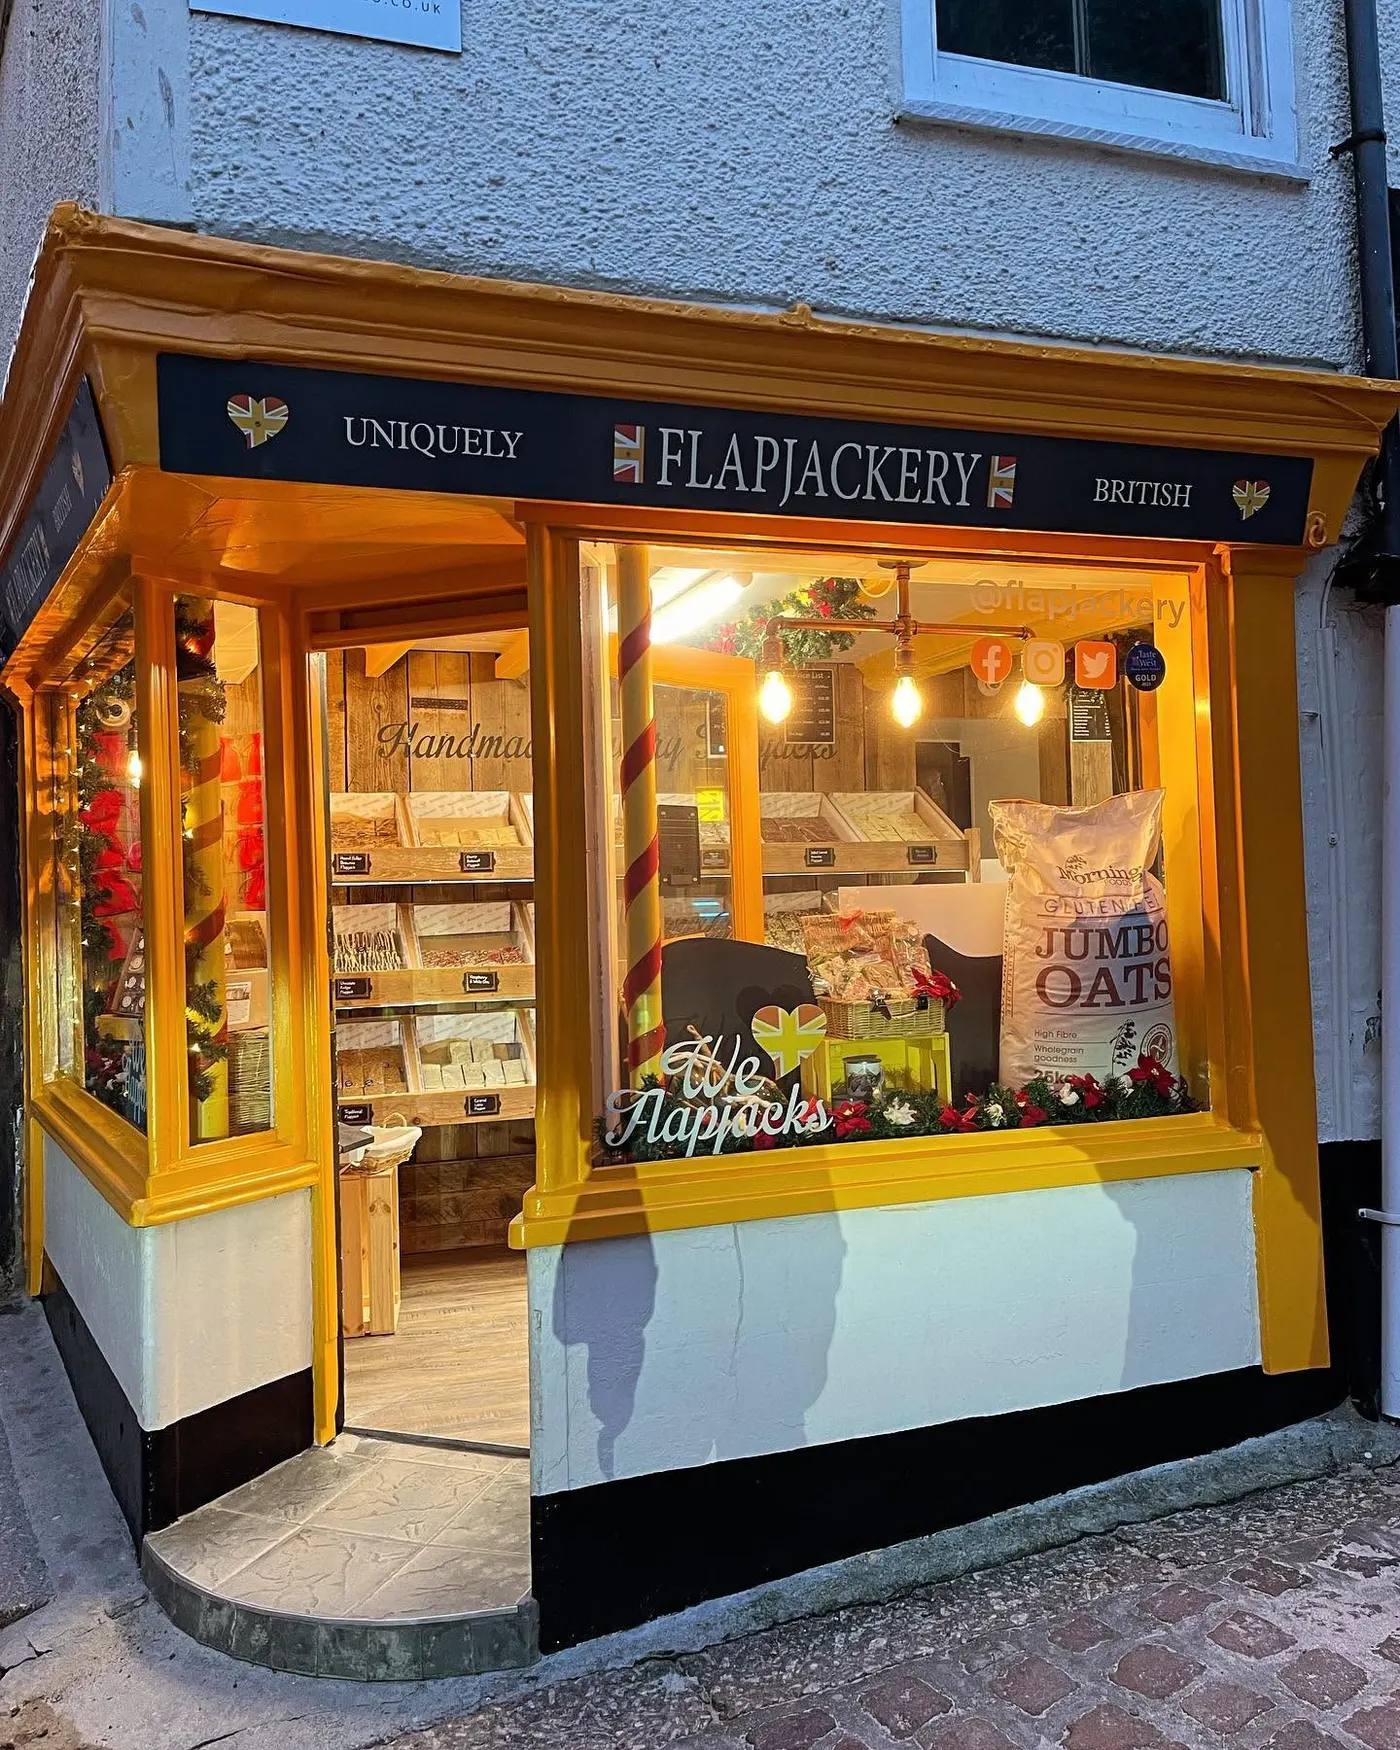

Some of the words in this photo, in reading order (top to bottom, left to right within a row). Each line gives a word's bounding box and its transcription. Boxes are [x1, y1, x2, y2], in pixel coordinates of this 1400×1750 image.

[343, 416, 523, 458] UNIQUELY
[657, 427, 982, 507] FLAPJACKERY
[1093, 478, 1193, 507] BRITISH
[970, 579, 1185, 628] @flapjackery
[1135, 674, 1157, 682] GOLD
[1057, 865, 1143, 885] Morning
[1044, 898, 1125, 915] GLUTEN
[1035, 920, 1169, 961] JUMBO
[1035, 956, 1172, 1008] OATS
[1034, 1029, 1054, 1040] High
[1056, 1030, 1077, 1039] Fibre
[1034, 1044, 1084, 1056] Wholegrain
[1034, 1054, 1078, 1064] goodness
[659, 1033, 767, 1100] We
